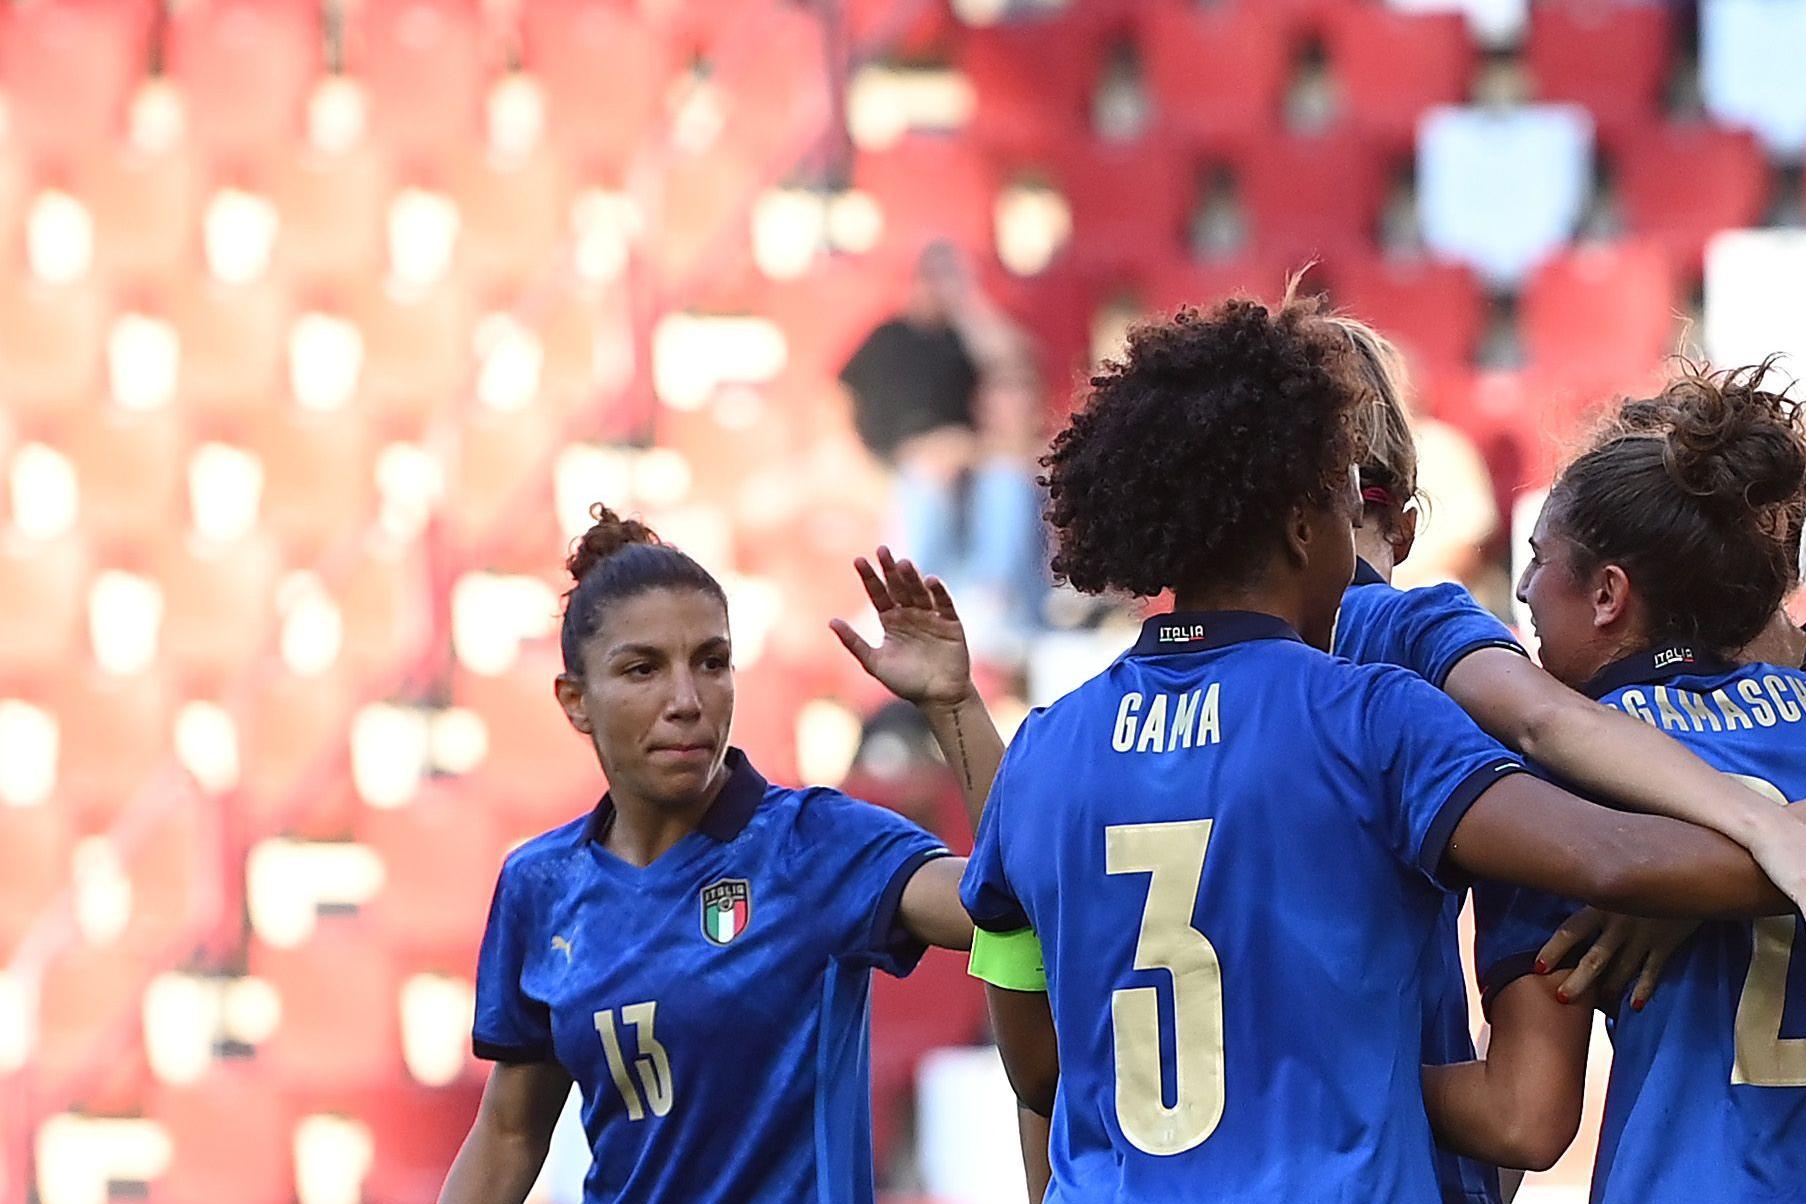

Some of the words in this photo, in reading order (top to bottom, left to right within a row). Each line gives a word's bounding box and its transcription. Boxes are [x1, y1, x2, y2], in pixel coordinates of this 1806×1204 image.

[1160, 624, 1204, 640] ITALIA
[1654, 647, 1694, 667] ITALIA
[1111, 682, 1221, 753] GAMA
[1104, 818, 1225, 1156] 3
[594, 1000, 674, 1122] 13
